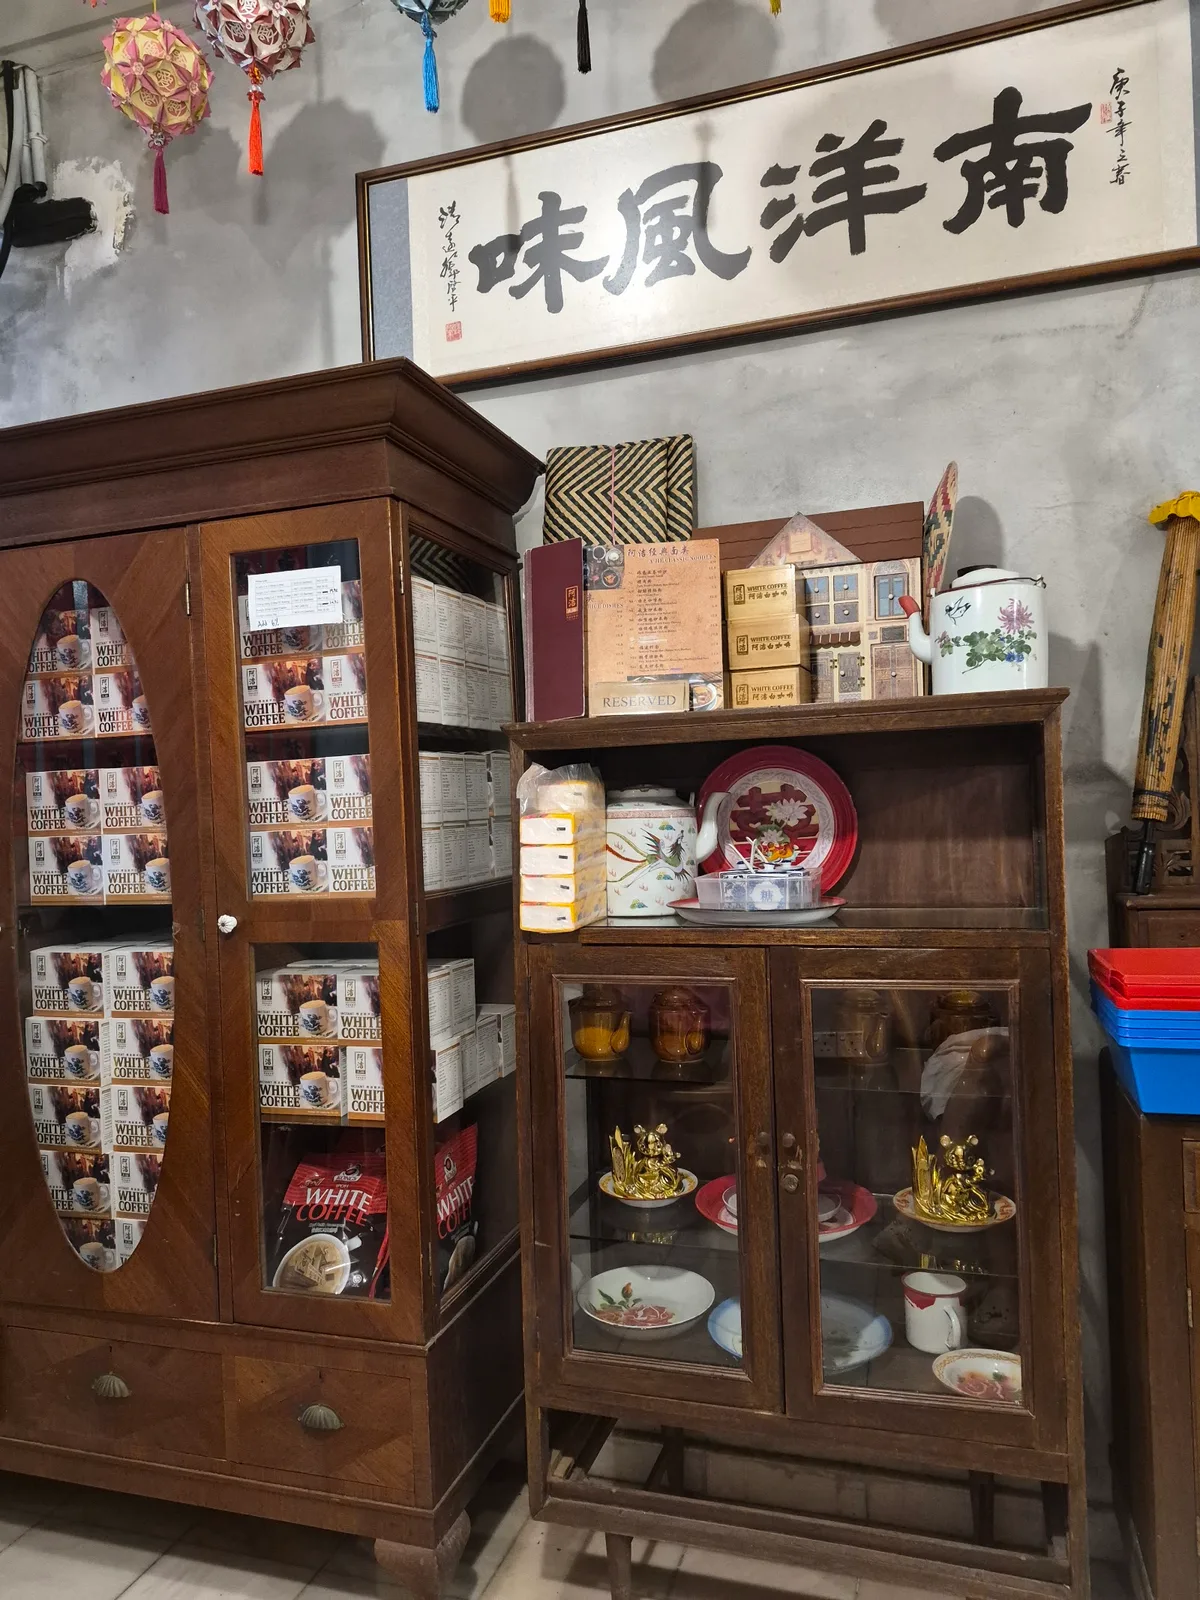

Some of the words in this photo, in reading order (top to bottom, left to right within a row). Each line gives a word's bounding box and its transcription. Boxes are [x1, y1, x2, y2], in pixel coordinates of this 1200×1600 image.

[747, 584, 766, 592] WHITE
[767, 582, 788, 590] COFFEE
[243, 630, 282, 646] WHITE
[33, 650, 57, 662] HITE
[96, 644, 124, 656] WHIT
[244, 644, 283, 658] COFFEE
[29, 661, 58, 672] OFFEE
[97, 655, 126, 666] COFFE
[603, 695, 677, 708] RESERVED
[244, 702, 284, 716] WHITE
[24, 715, 59, 727] WHITE
[98, 710, 132, 722] WHITE
[246, 713, 286, 726] COFFEE
[25, 726, 60, 738] COFFEE
[99, 721, 133, 732] COFFEE
[248, 800, 288, 813] WHITE
[330, 795, 372, 808] WHITE
[30, 808, 66, 820] WHITE
[104, 806, 142, 817] WHITE
[332, 808, 372, 820] COFFEE
[105, 816, 142, 828] COFFEE
[249, 812, 289, 824] COFFEE
[31, 819, 66, 830] COFFEE
[32, 874, 68, 885] WHITE
[108, 872, 146, 884] WHITE
[252, 870, 289, 882] WHITE
[332, 867, 374, 880] WHITE
[33, 884, 68, 895] COFFEE
[108, 884, 146, 894] COFFEE
[252, 882, 290, 894] COFFEE
[332, 880, 374, 892] COFFEE
[34, 988, 68, 1000] WHITE
[114, 989, 150, 1000] WHITE
[35, 1000, 70, 1010] COFFEE
[114, 1000, 151, 1011] COFFEE
[258, 1014, 299, 1026] WHITE
[258, 1026, 300, 1036] COFFEE
[30, 1056, 65, 1068] WHITE
[114, 1056, 151, 1068] WHITE
[30, 1068, 65, 1078] COFFEE
[114, 1068, 151, 1078] COFFEE
[260, 1084, 300, 1096] WHITE
[351, 1088, 384, 1102] WHIT
[260, 1096, 300, 1108] COFFEE
[116, 1124, 153, 1136] WHITE
[37, 1134, 66, 1145] OFFEE
[116, 1135, 154, 1146] COFFEE
[118, 1200, 150, 1213] COFFE
[306, 1188, 372, 1213] WHITE
[296, 1204, 367, 1227] COFFEE
